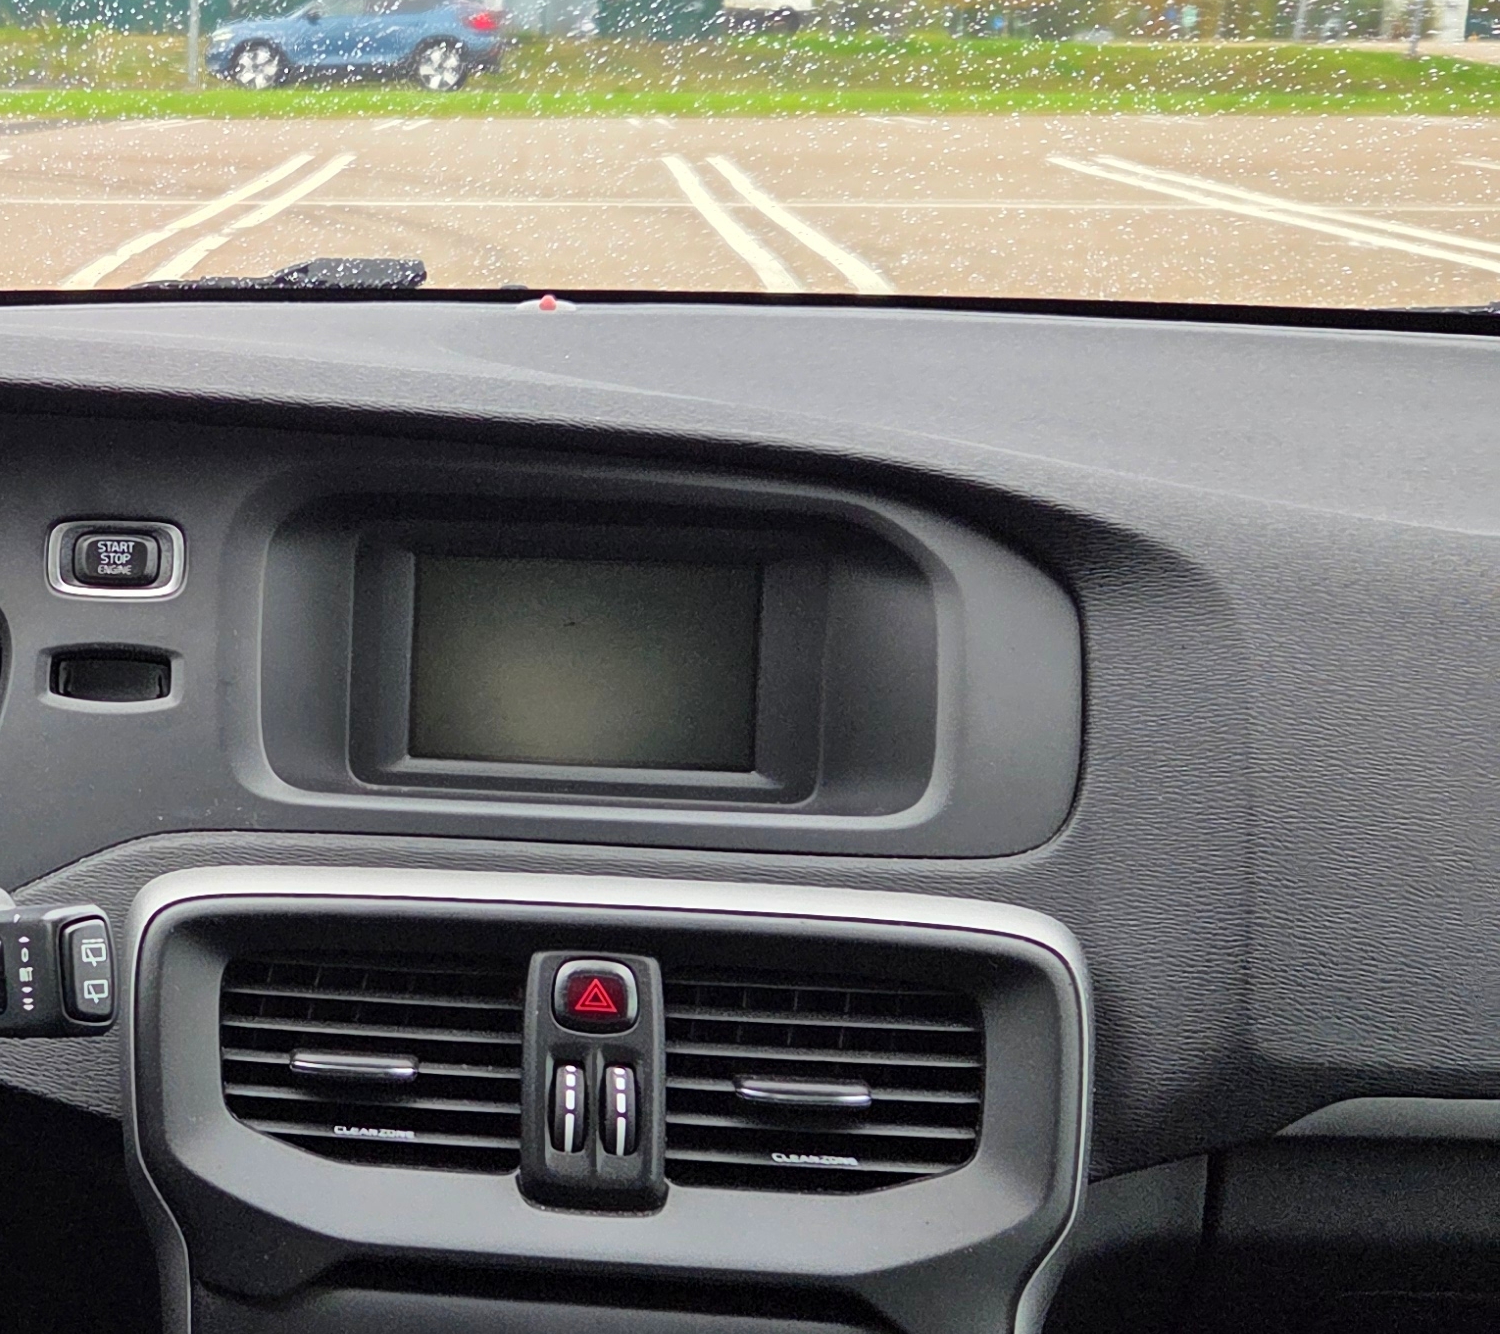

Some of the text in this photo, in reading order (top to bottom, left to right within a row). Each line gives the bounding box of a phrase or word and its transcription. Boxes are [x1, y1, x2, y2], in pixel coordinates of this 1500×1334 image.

[98, 541, 135, 553] START
[100, 553, 131, 564] STOP
[97, 565, 132, 575] ENGINE
